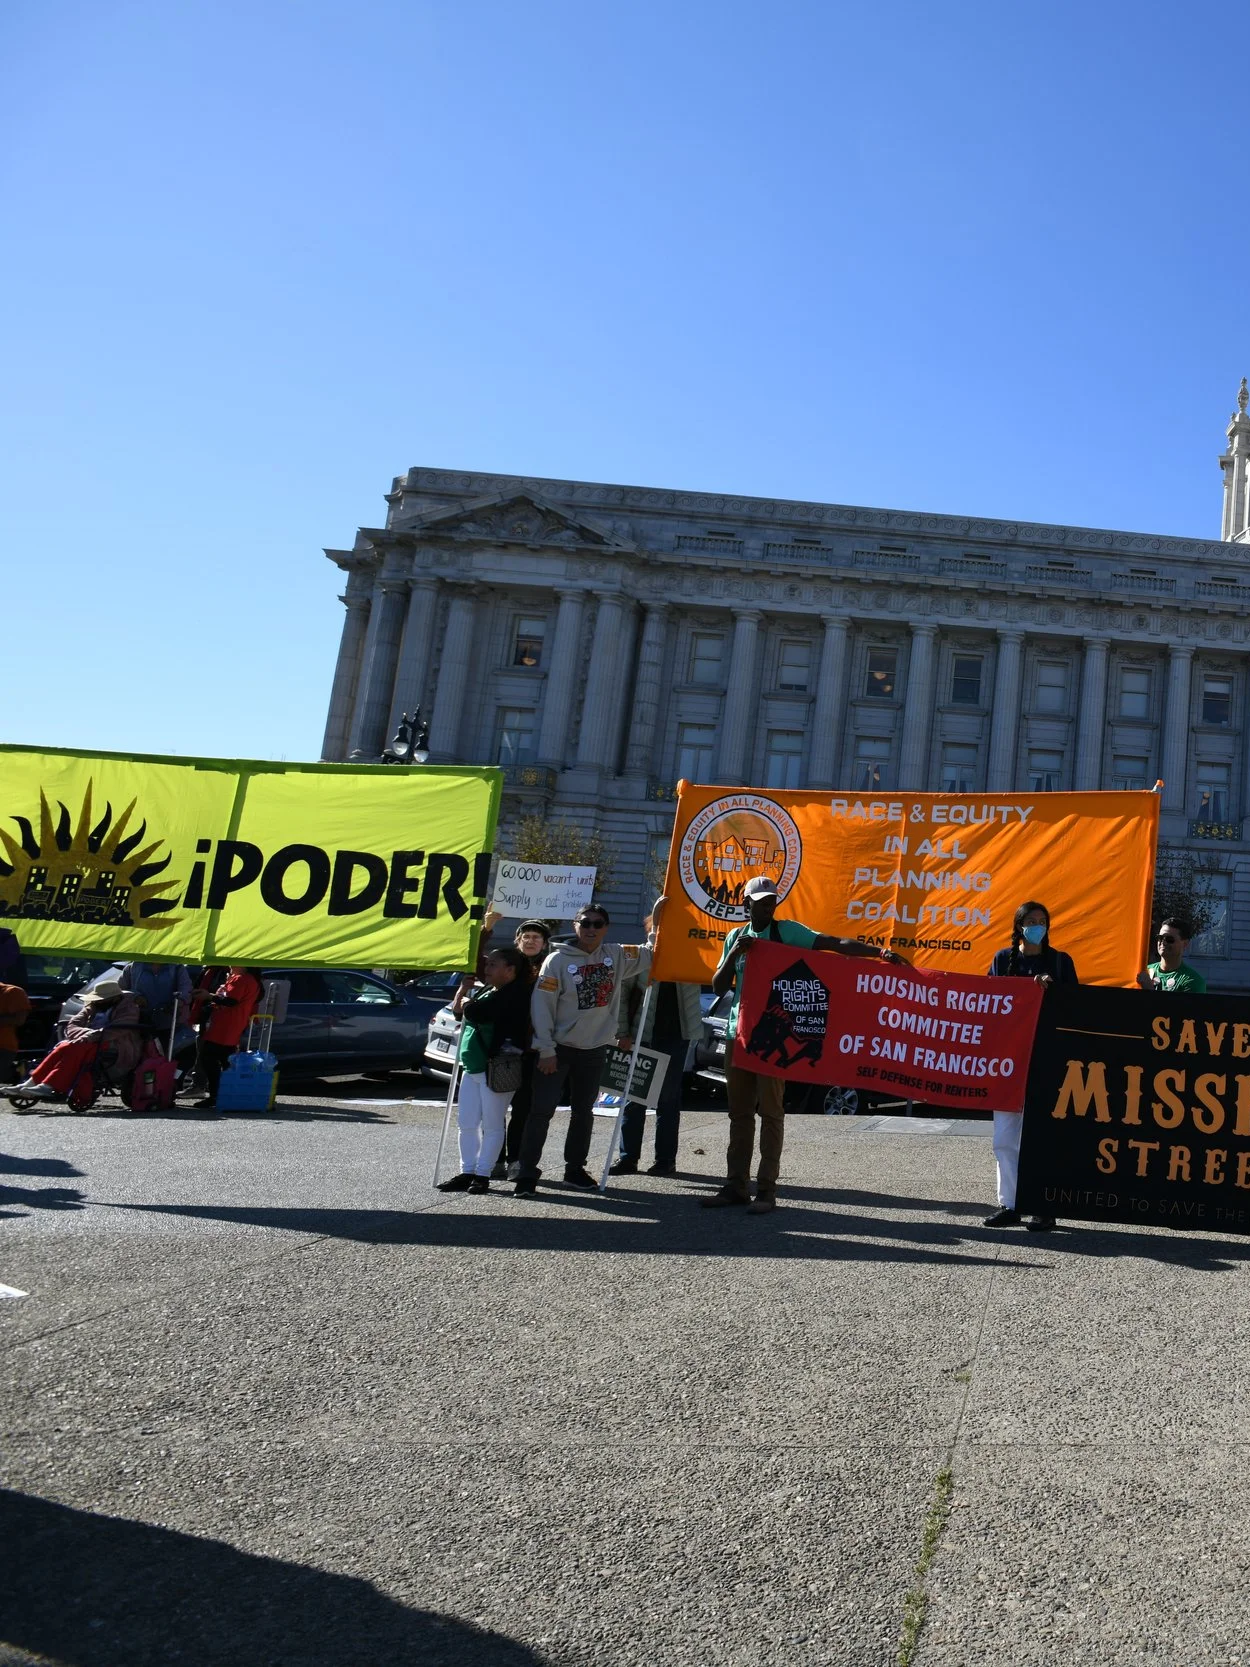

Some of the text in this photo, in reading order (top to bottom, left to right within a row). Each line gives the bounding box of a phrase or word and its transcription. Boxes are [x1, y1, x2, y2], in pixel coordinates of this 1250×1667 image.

[831, 798, 1034, 825] RACE & EQUITY
[682, 851, 694, 884] RACE
[688, 807, 715, 842] EQUITY
[718, 801, 729, 811] IN
[731, 797, 750, 807] ALL
[752, 799, 794, 838] PLANNING
[883, 835, 967, 860] IN ALL
[543, 872, 573, 884] vacant
[576, 874, 594, 886] units
[854, 868, 992, 892] PLANNING
[494, 886, 582, 910] Supply is not the
[846, 901, 991, 927] COALITION
[857, 935, 971, 951] SAN FRANCISCO
[773, 980, 820, 991] HOUSING
[782, 989, 826, 1003] RIGHTS
[856, 974, 1014, 1015] HOUSING RIGHTS
[783, 1002, 828, 1012] COMMITTEE
[793, 1026, 826, 1034] FRANCISCO
[878, 1006, 983, 1045] COMMITTEE
[612, 1050, 652, 1070] HANC
[839, 1034, 1014, 1077] OF SAN FRANCISCO
[856, 1066, 988, 1098] SELF DEFENSE FOR RENTERS
[1044, 1187, 1118, 1208] UNITED
[1129, 1198, 1149, 1212] TO
[1159, 1199, 1206, 1217] SAVE
[1215, 1207, 1245, 1223] THE
